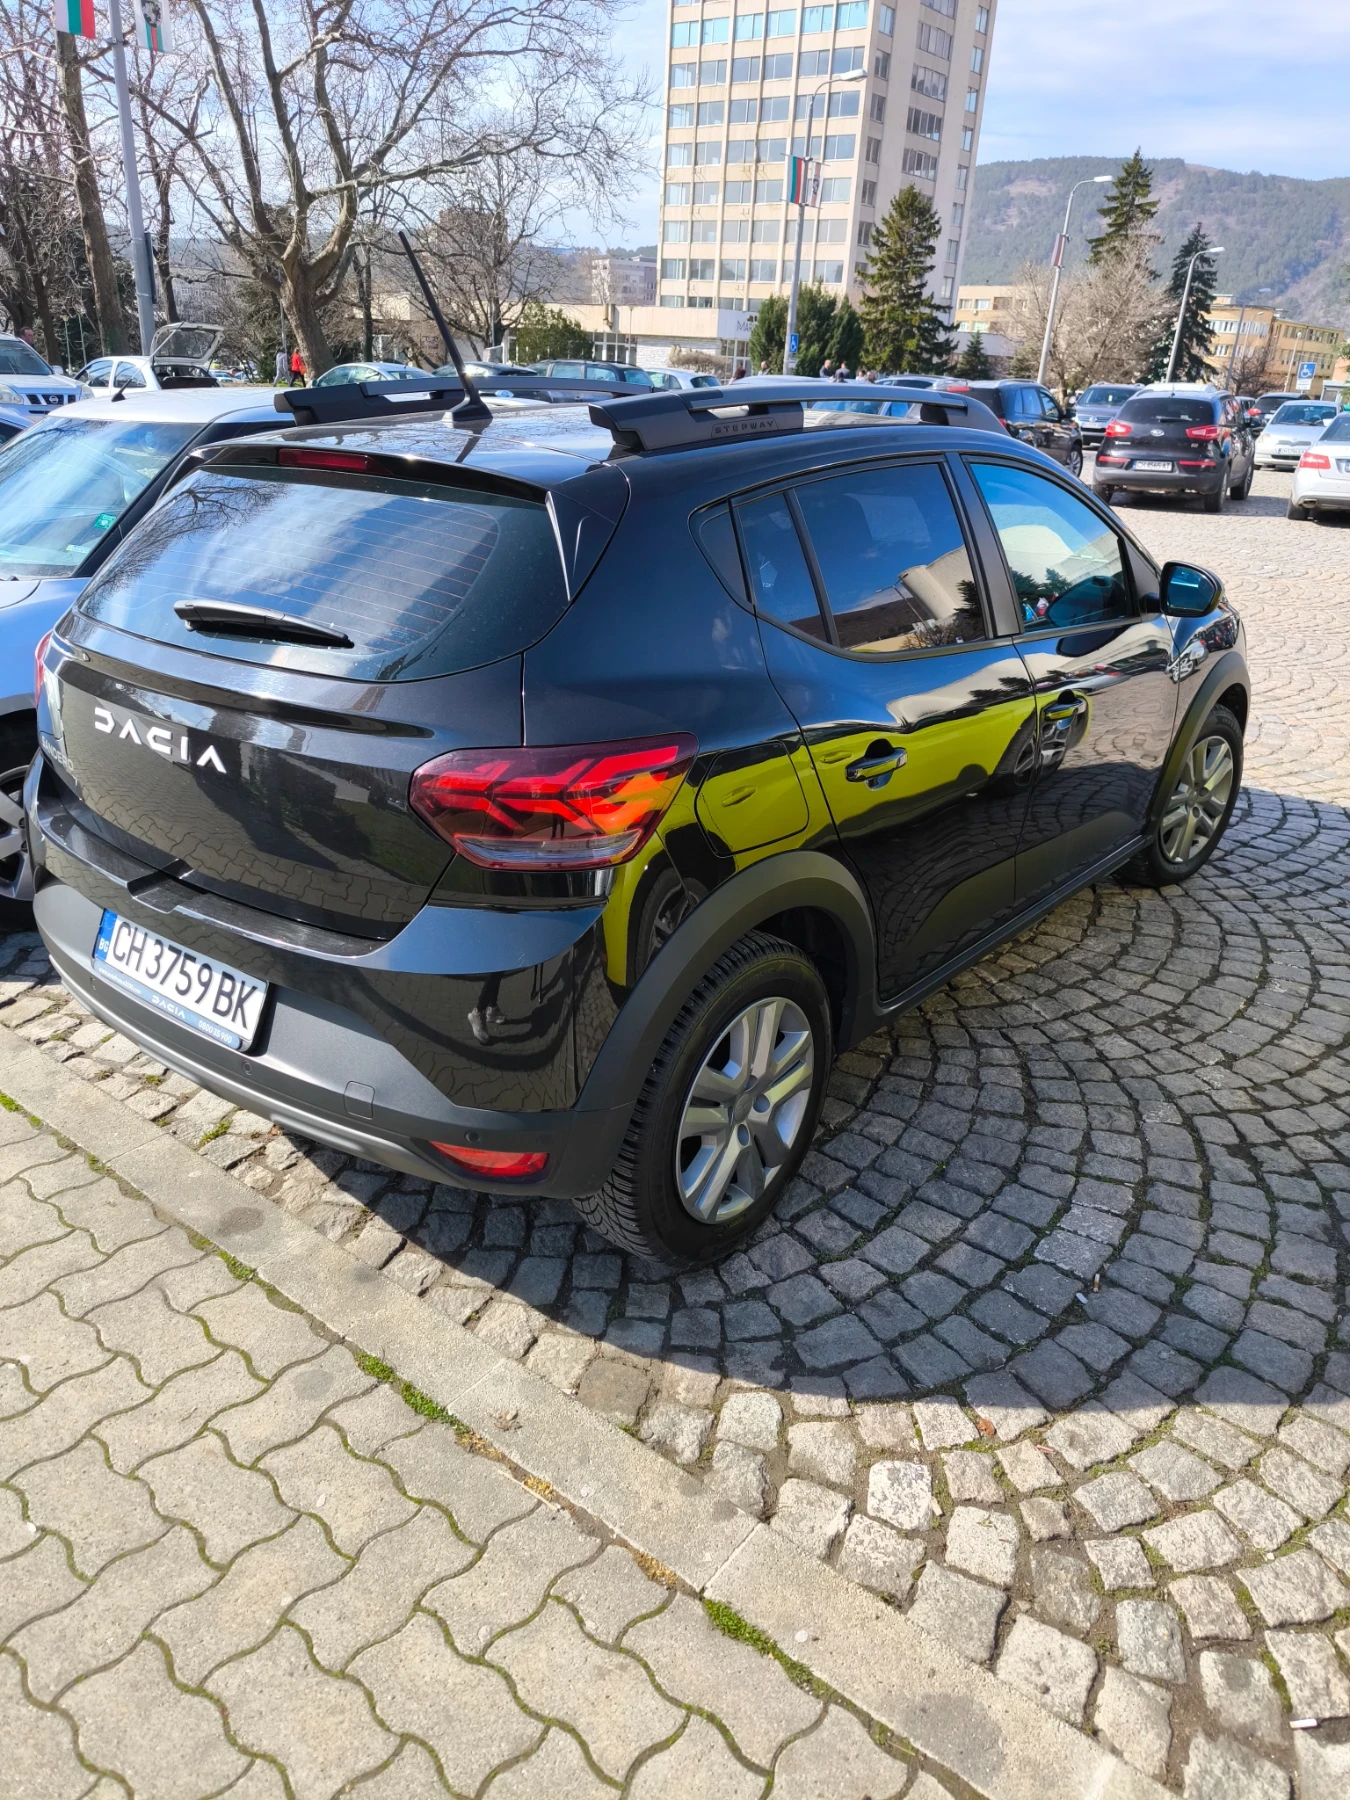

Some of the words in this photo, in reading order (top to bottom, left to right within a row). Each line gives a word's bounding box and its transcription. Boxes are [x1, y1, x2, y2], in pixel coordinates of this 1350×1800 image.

[714, 420, 773, 434] STEPWAY
[94, 706, 227, 774] DACIA
[41, 735, 75, 772] SANDERO
[98, 937, 110, 953] BG
[151, 994, 186, 1020] DACIA
